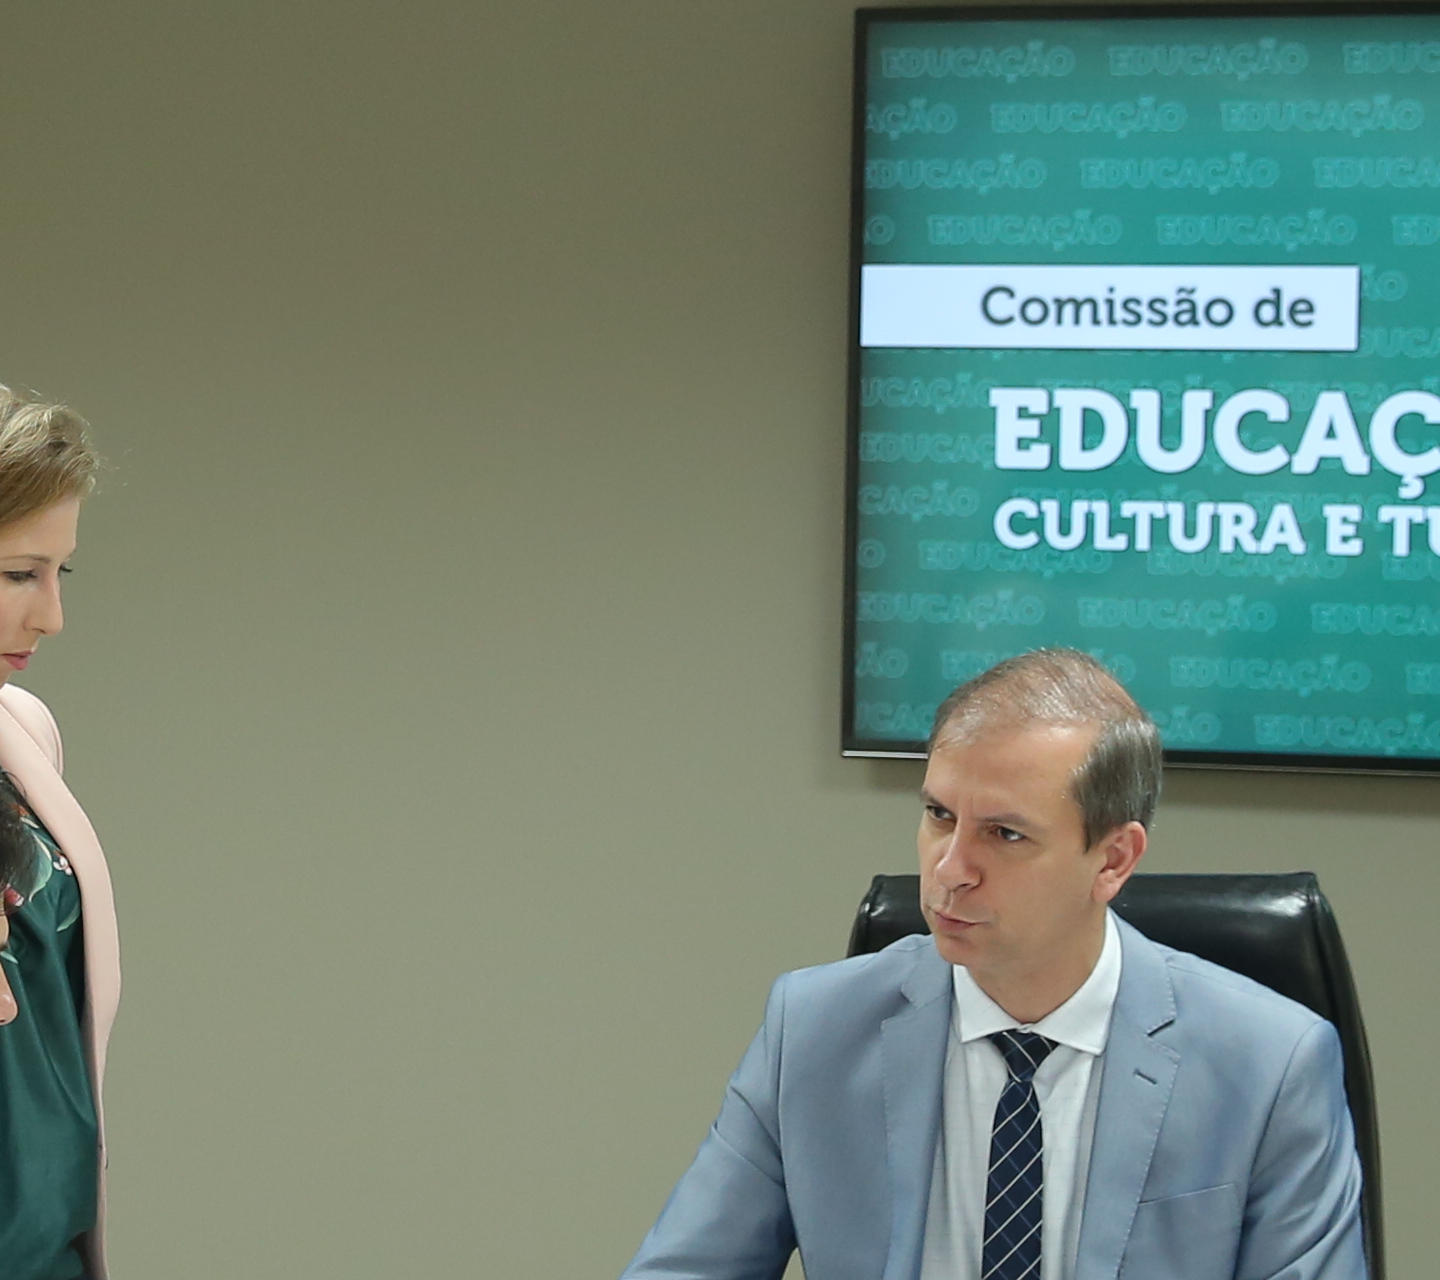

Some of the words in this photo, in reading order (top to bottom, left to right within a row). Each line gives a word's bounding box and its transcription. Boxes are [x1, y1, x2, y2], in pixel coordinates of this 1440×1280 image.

[880, 40, 1076, 84] EDUCAÇÃO
[1107, 38, 1309, 82] EDUCAÇÃO
[989, 95, 1188, 138] EDUCAÇÃO
[1220, 93, 1422, 137] EDUCAÇÃO
[1080, 151, 1280, 194] EDUCAÇÃO
[980, 286, 1236, 329] Comissão
[1252, 287, 1316, 329] de
[992, 496, 1306, 555] CULTURA
[1323, 502, 1364, 555] E
[1078, 595, 1277, 636] EDUCAÇÃO
[1170, 654, 1372, 698] EDUCAÇÃO
